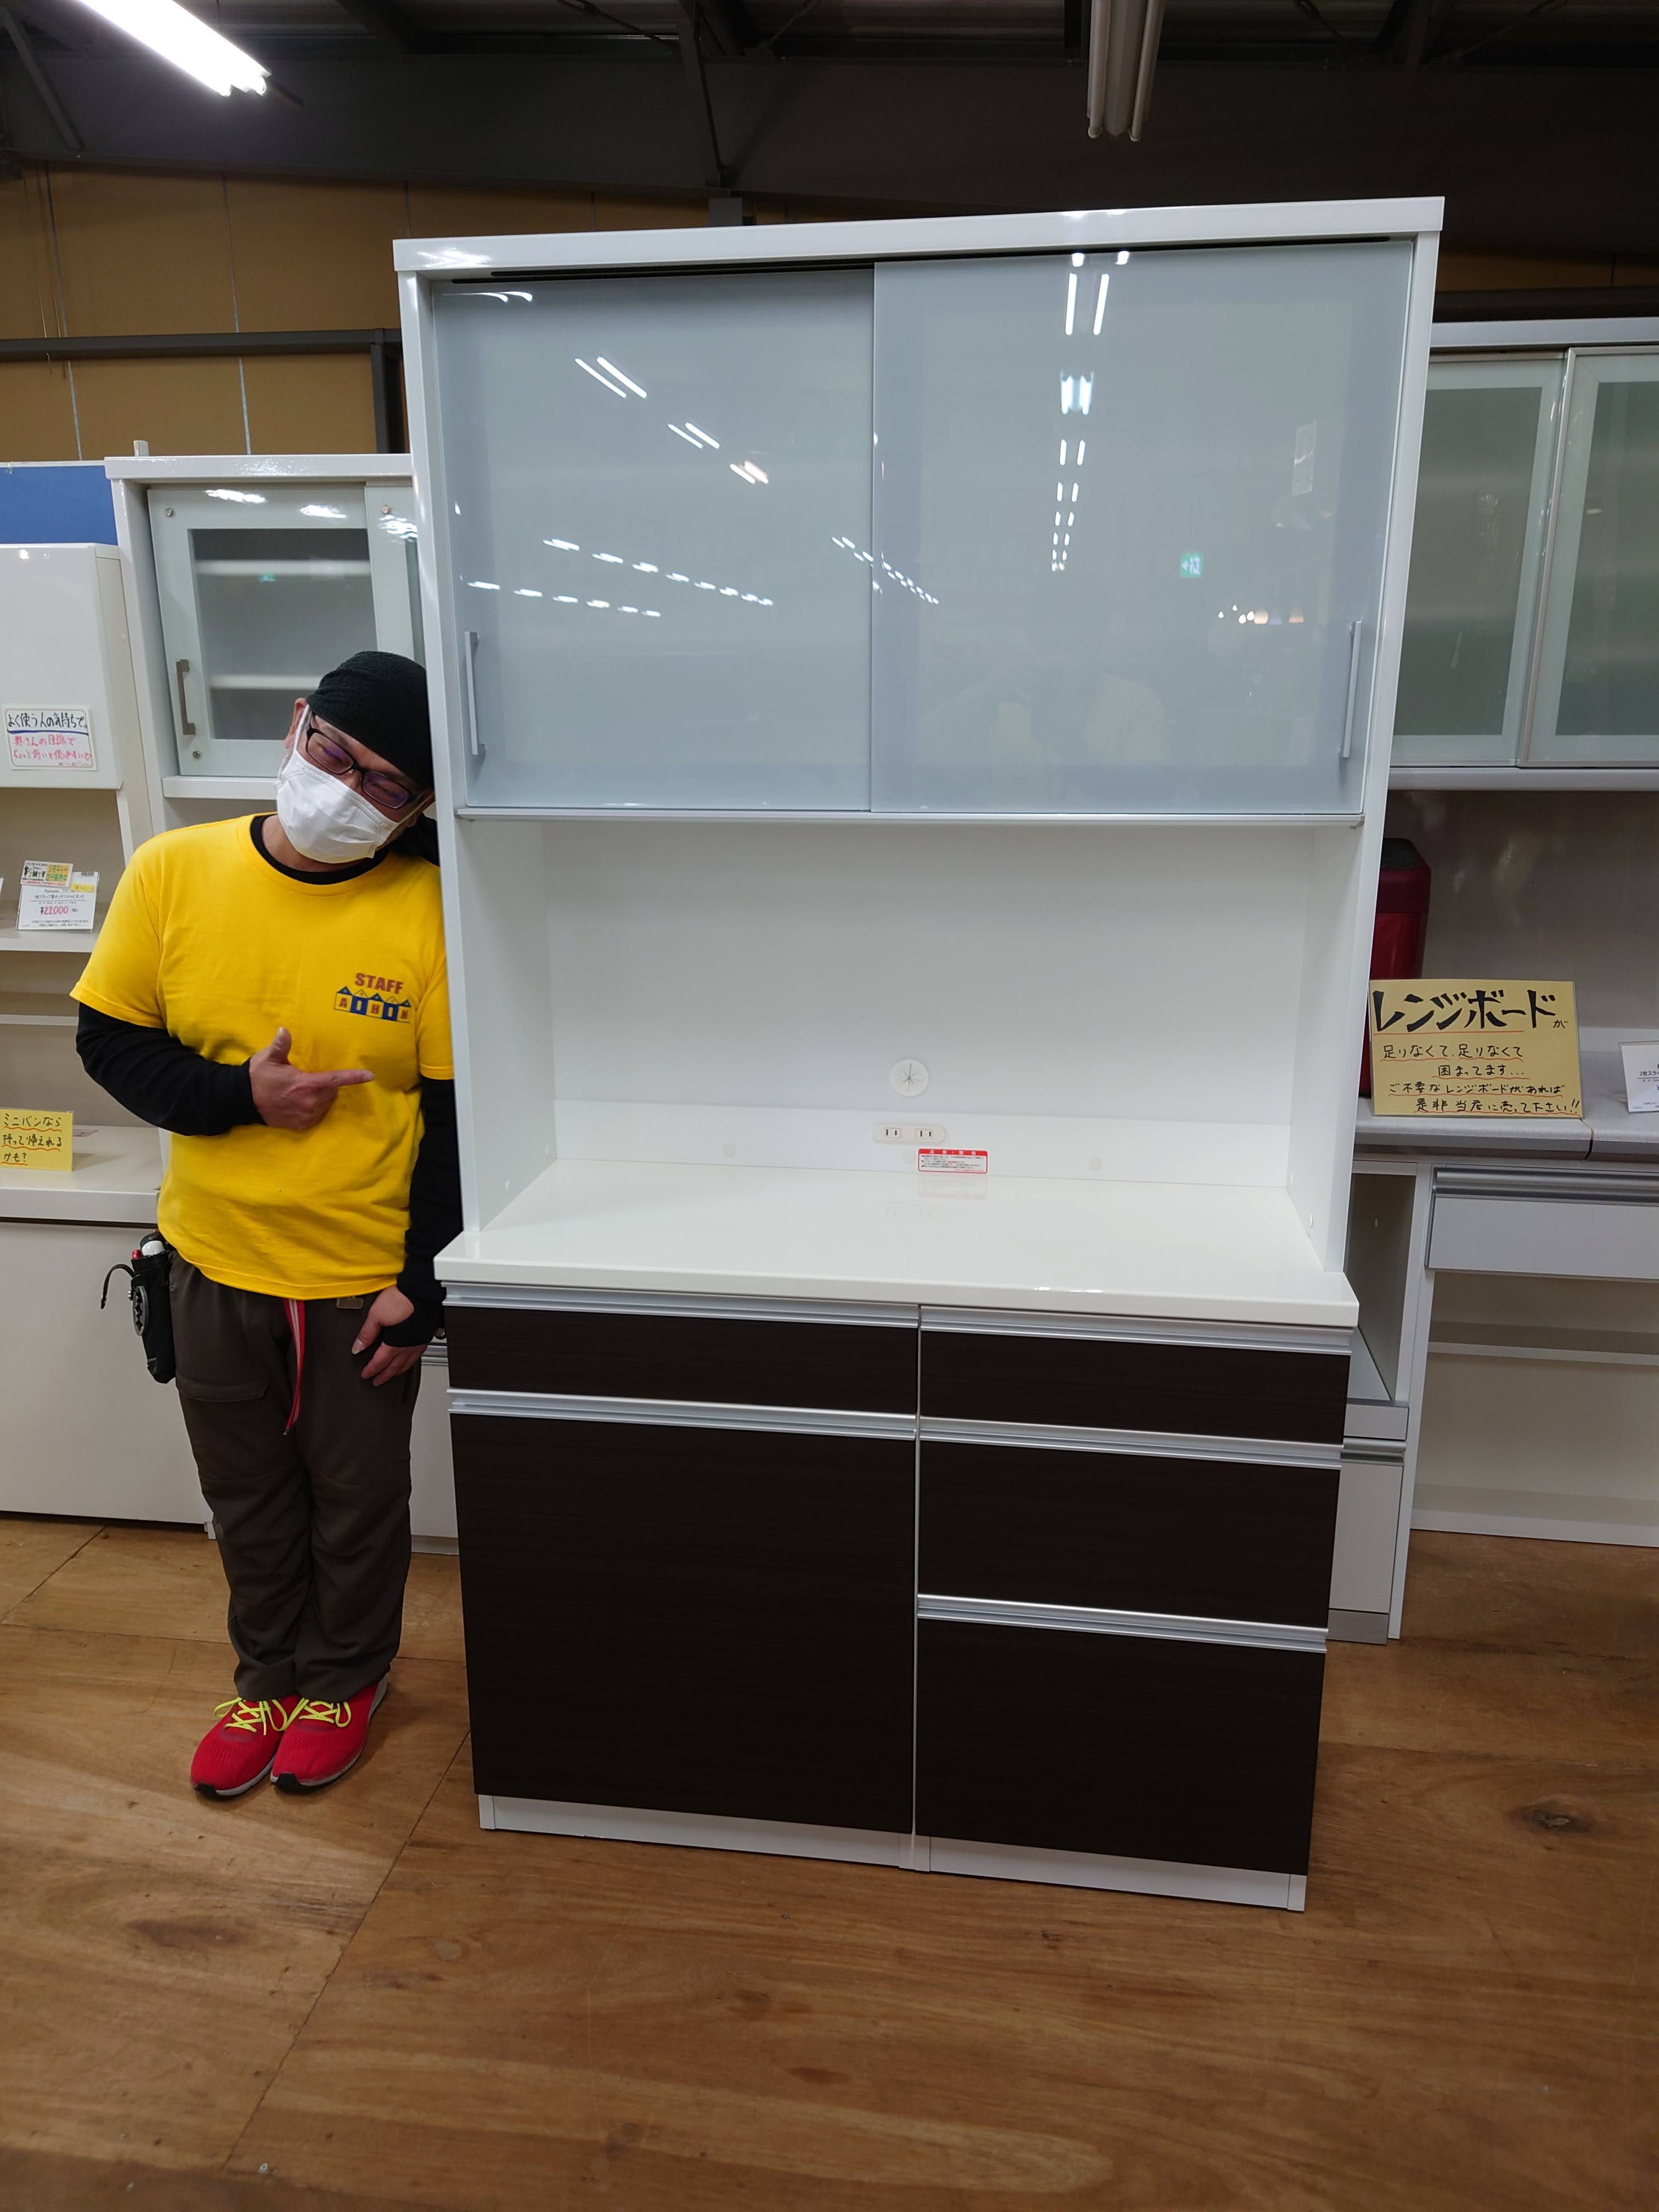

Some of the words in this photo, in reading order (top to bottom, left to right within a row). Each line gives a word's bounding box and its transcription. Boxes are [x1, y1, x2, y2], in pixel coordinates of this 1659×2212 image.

[354, 972, 404, 994] STAFF
[1389, 1081, 1565, 1094] ご不要なレンジボードがあれば
[4, 1113, 61, 1127] ミニバンなら
[2, 1133, 62, 1147] 持って帰えれる
[4, 1152, 27, 1163] かも?
